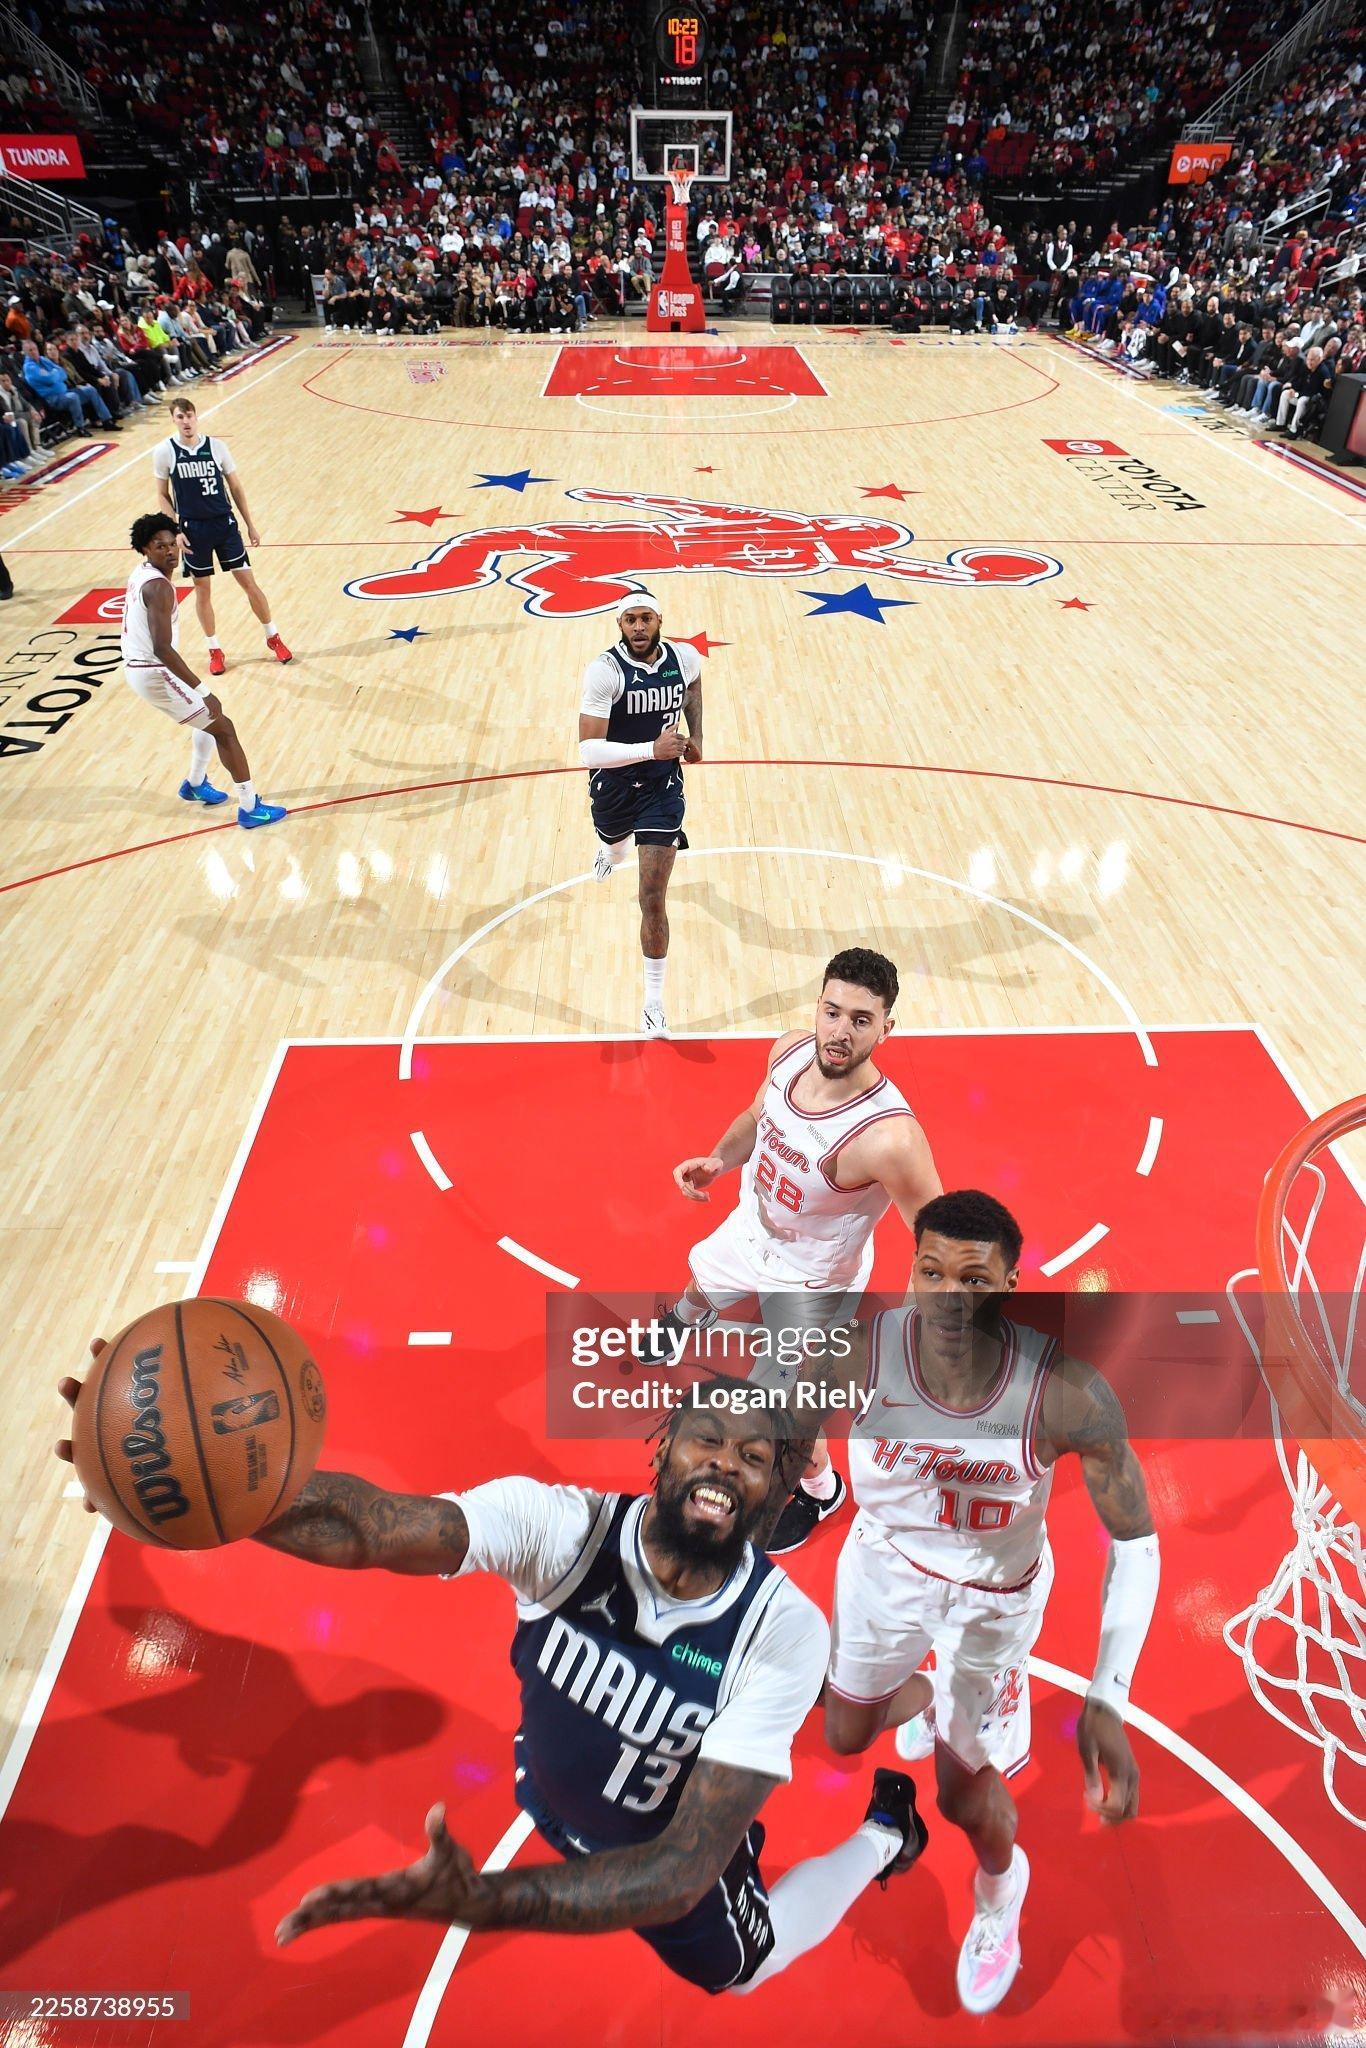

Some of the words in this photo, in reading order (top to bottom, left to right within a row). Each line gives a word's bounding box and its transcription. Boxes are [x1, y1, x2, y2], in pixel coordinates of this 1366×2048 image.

[668, 18, 698, 36] 10:23
[675, 35, 696, 65] 18
[6, 147, 70, 166] TUNDRA
[669, 303, 688, 317] Pass
[177, 460, 216, 479] MAVS
[199, 477, 219, 496] 32
[1066, 457, 1157, 511] CENTER
[1108, 458, 1207, 512] TOYOTA
[627, 683, 684, 715] MAVS
[754, 1150, 805, 1214] 28
[122, 1342, 190, 1526] Wilson
[871, 1436, 1020, 1485] H-Town
[935, 1487, 1015, 1531] 10
[671, 1642, 723, 1678] chime
[537, 1615, 715, 1758] MAVS
[602, 1742, 682, 1812] 13
